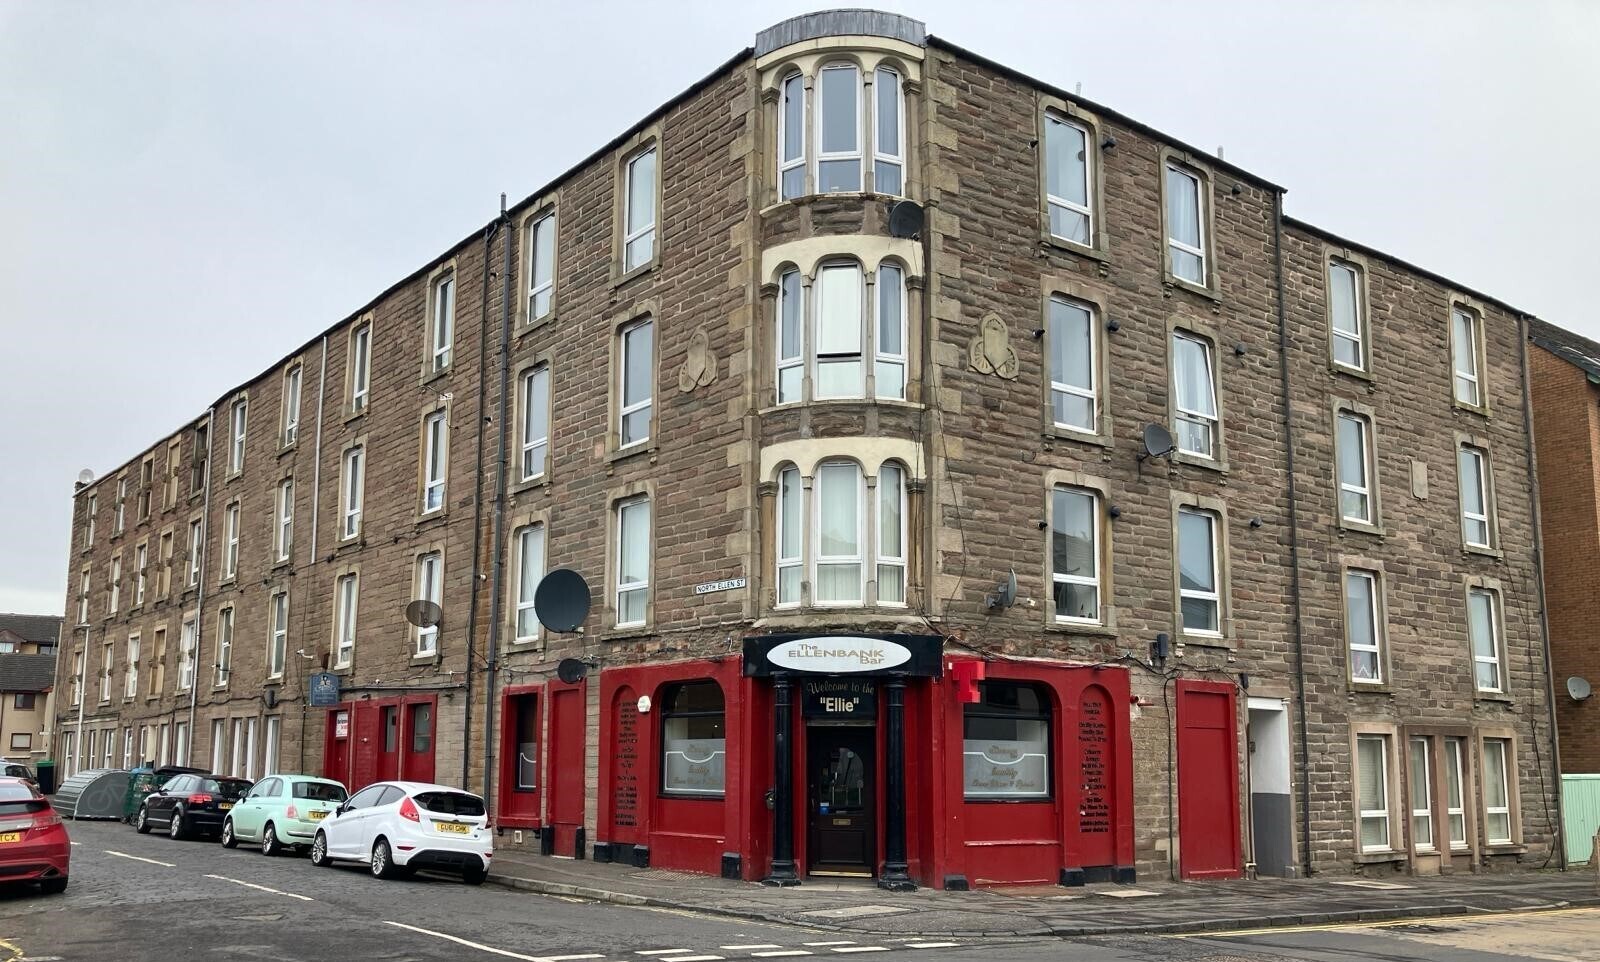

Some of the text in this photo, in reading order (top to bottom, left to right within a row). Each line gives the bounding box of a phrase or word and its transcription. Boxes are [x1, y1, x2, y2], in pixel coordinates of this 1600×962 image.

[718, 581, 735, 589] ELLEN
[799, 643, 818, 651] The
[788, 649, 885, 658] ELLENBANK
[859, 657, 885, 665] Bar
[807, 681, 875, 695] Welcome to the
[820, 697, 859, 712] "Ellie"
